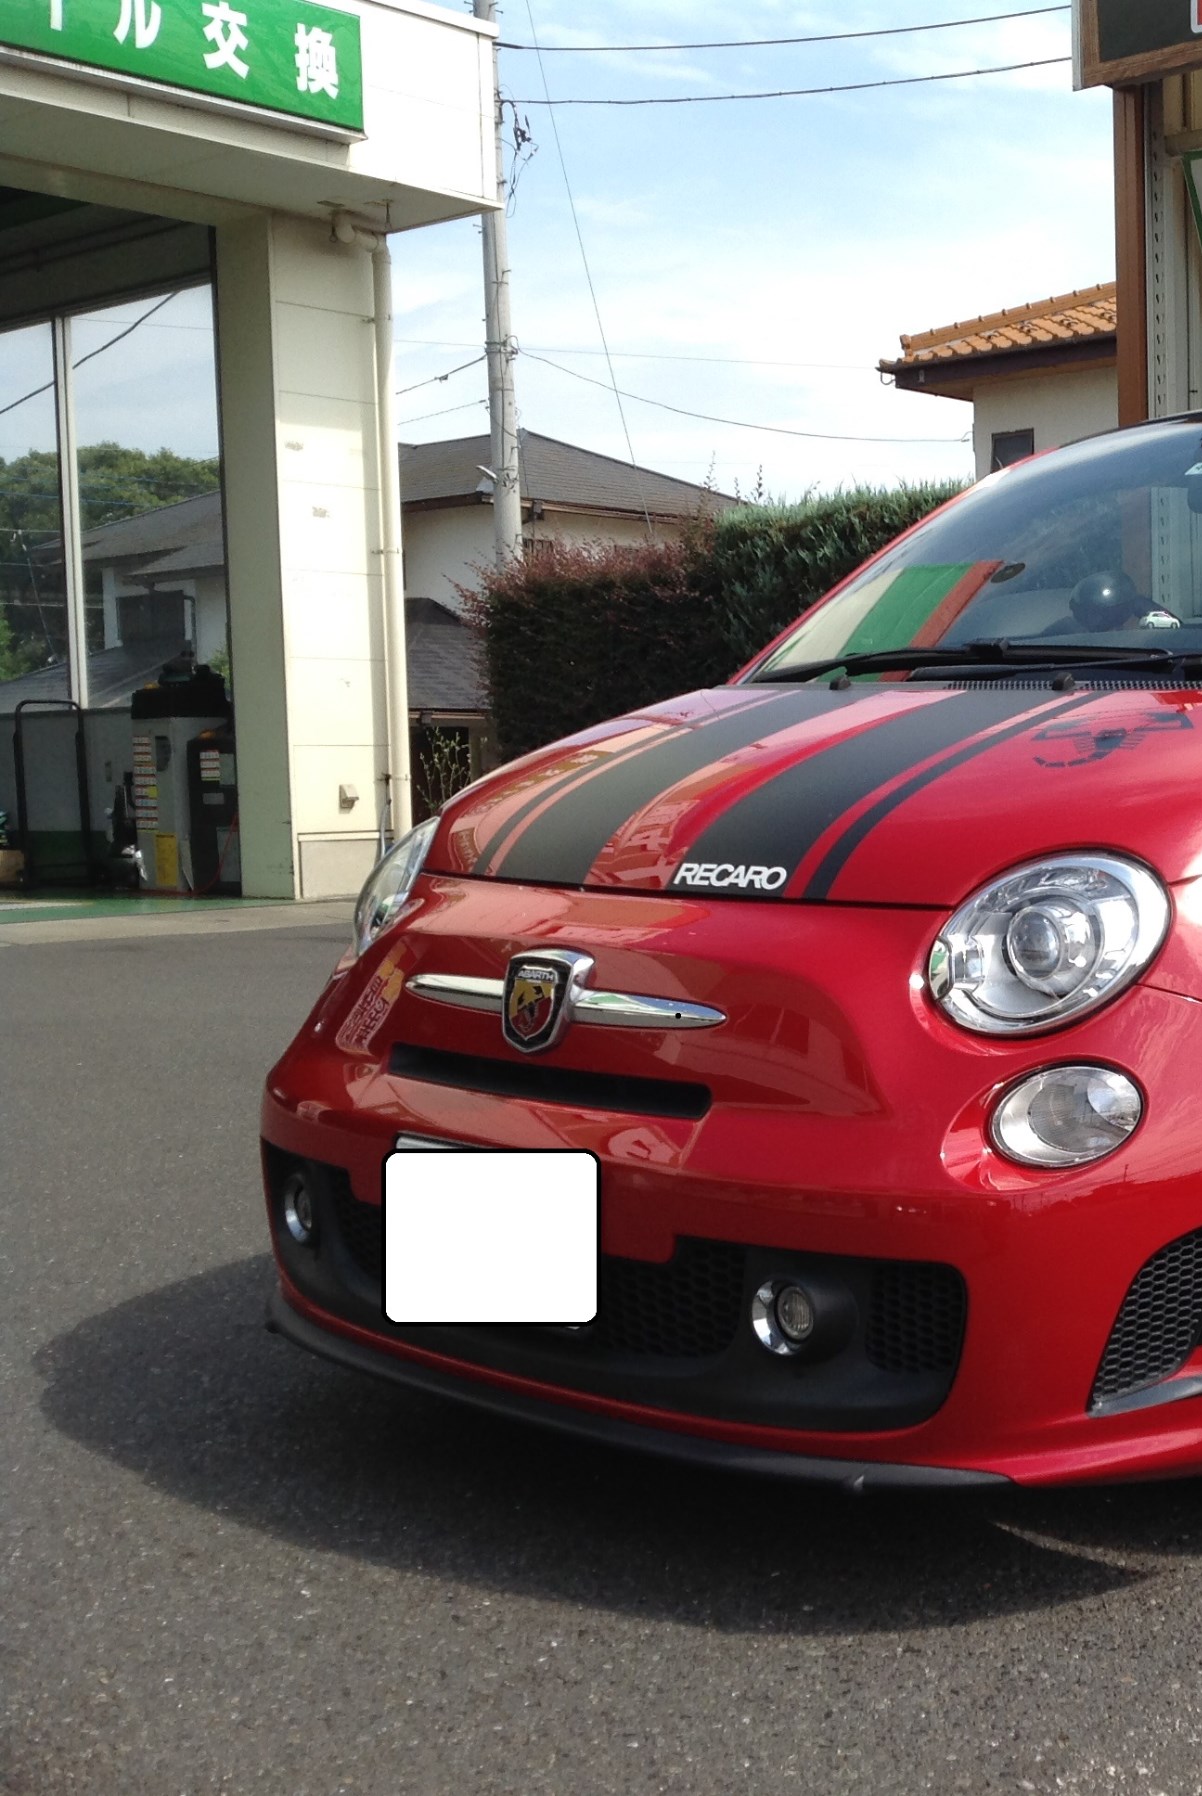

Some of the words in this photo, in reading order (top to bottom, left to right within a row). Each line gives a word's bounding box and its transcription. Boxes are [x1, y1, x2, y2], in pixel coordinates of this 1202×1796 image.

[48, 0, 340, 99] ル交換
[673, 862, 787, 891] RECARO
[518, 969, 554, 981] ABARTH
